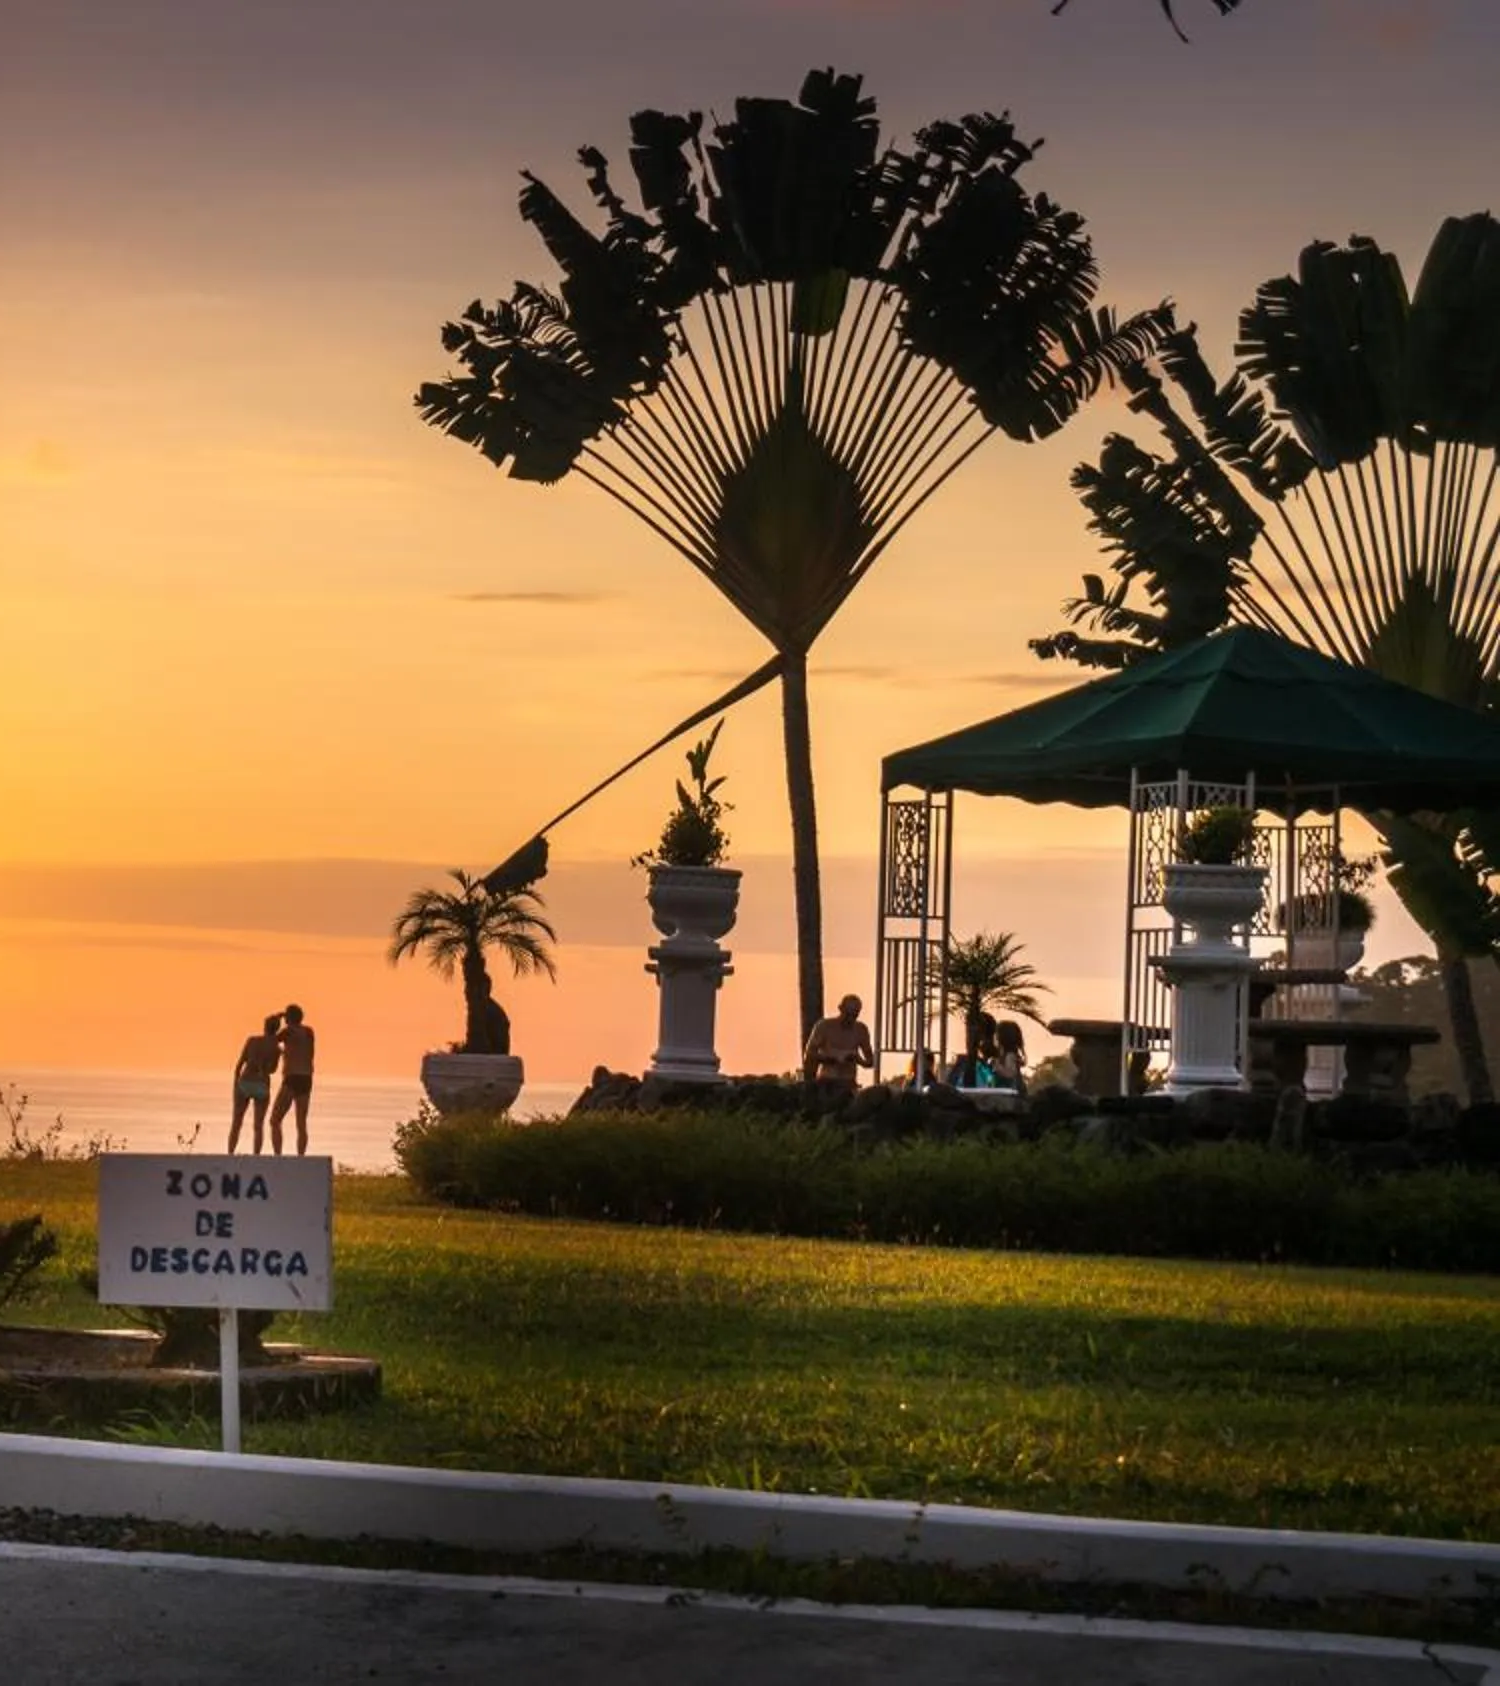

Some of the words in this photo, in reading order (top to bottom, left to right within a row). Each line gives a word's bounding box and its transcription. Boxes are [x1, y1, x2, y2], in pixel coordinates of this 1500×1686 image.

[165, 1170, 269, 1200] ZONA
[195, 1210, 233, 1238] DE
[130, 1246, 308, 1276] DESCARGA
